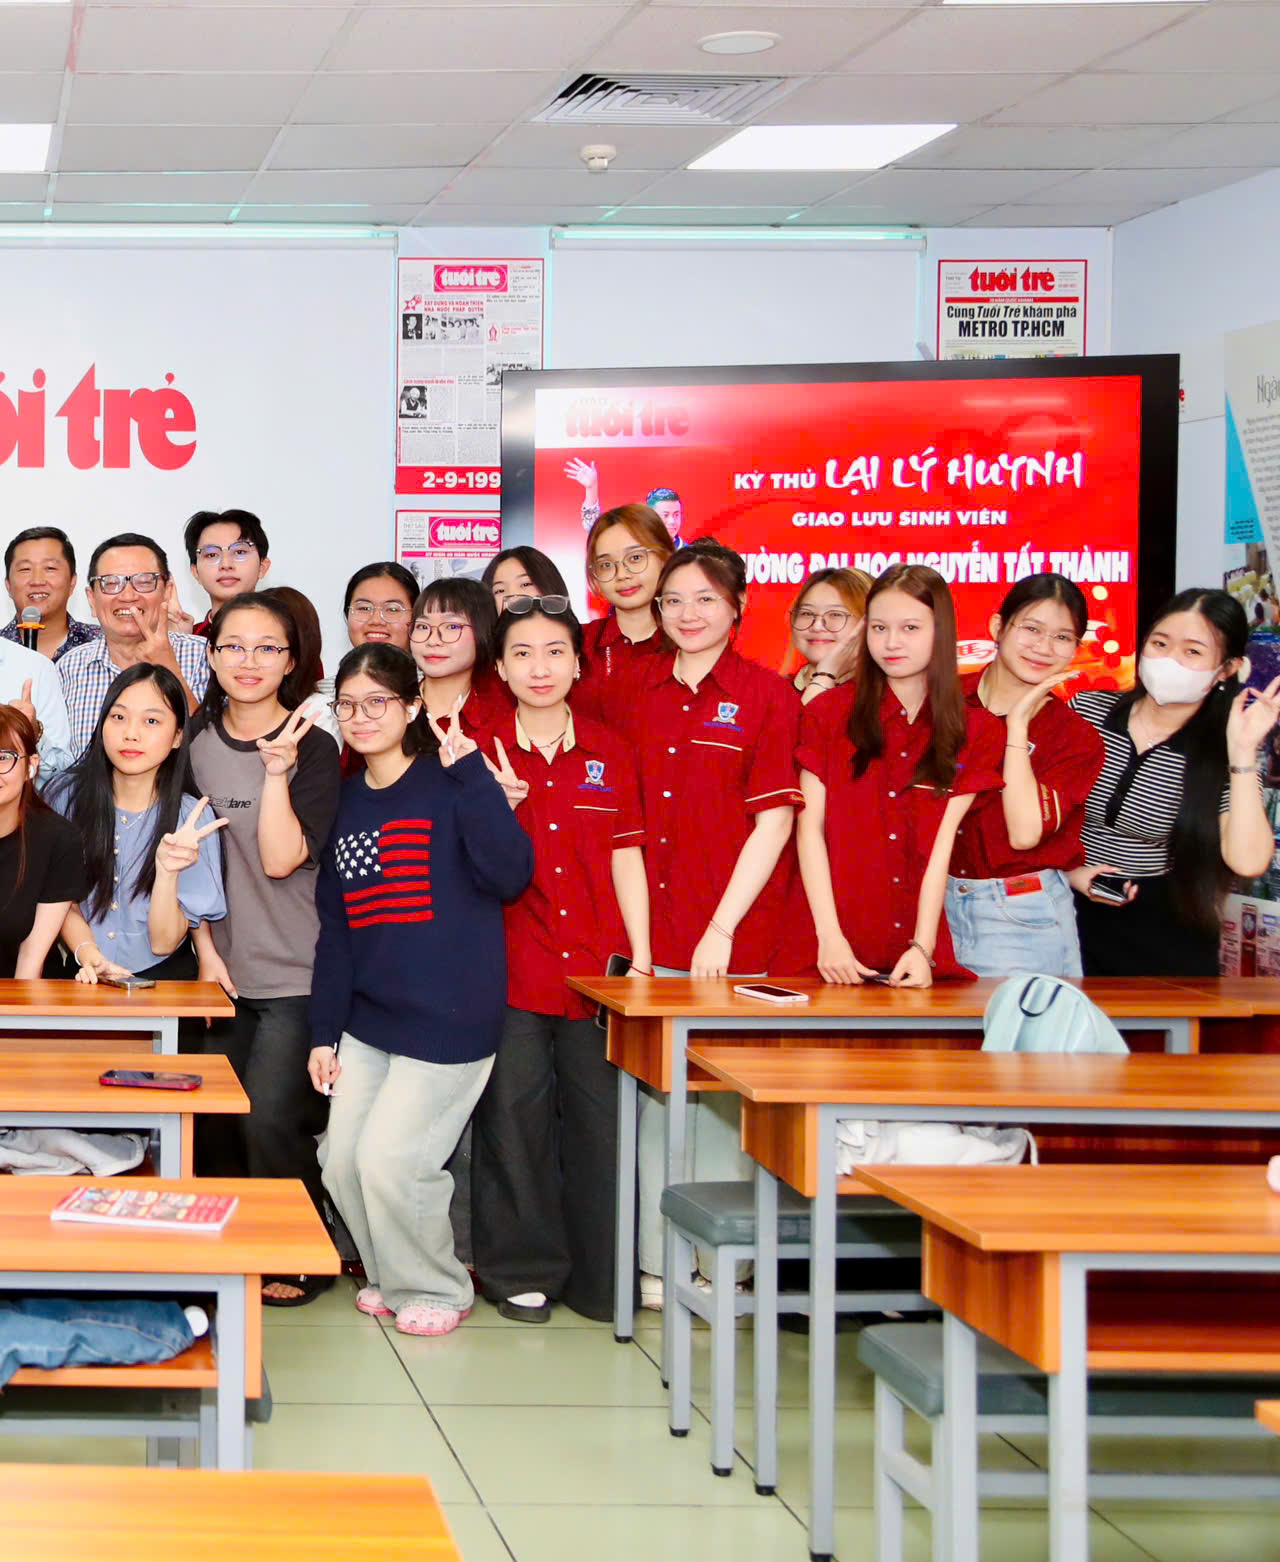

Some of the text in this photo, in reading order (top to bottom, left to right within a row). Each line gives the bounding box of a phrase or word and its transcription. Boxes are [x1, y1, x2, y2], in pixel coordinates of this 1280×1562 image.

[947, 305, 975, 319] Cùng
[1004, 305, 1021, 318] Trẻ
[1023, 305, 1053, 318] khám
[1056, 304, 1077, 319] phá
[959, 320, 1065, 337] METRO TP.HCM
[55, 362, 197, 471] trẻ
[422, 471, 501, 488] 2-9-199
[770, 467, 817, 489] THỦ
[825, 455, 880, 496] LẠI
[893, 445, 937, 493] LÝ
[792, 508, 1008, 527] GIAO LƯU SINH VIÊN
[1003, 541, 1045, 583] TẤT
[1050, 545, 1129, 583] THÀNH
